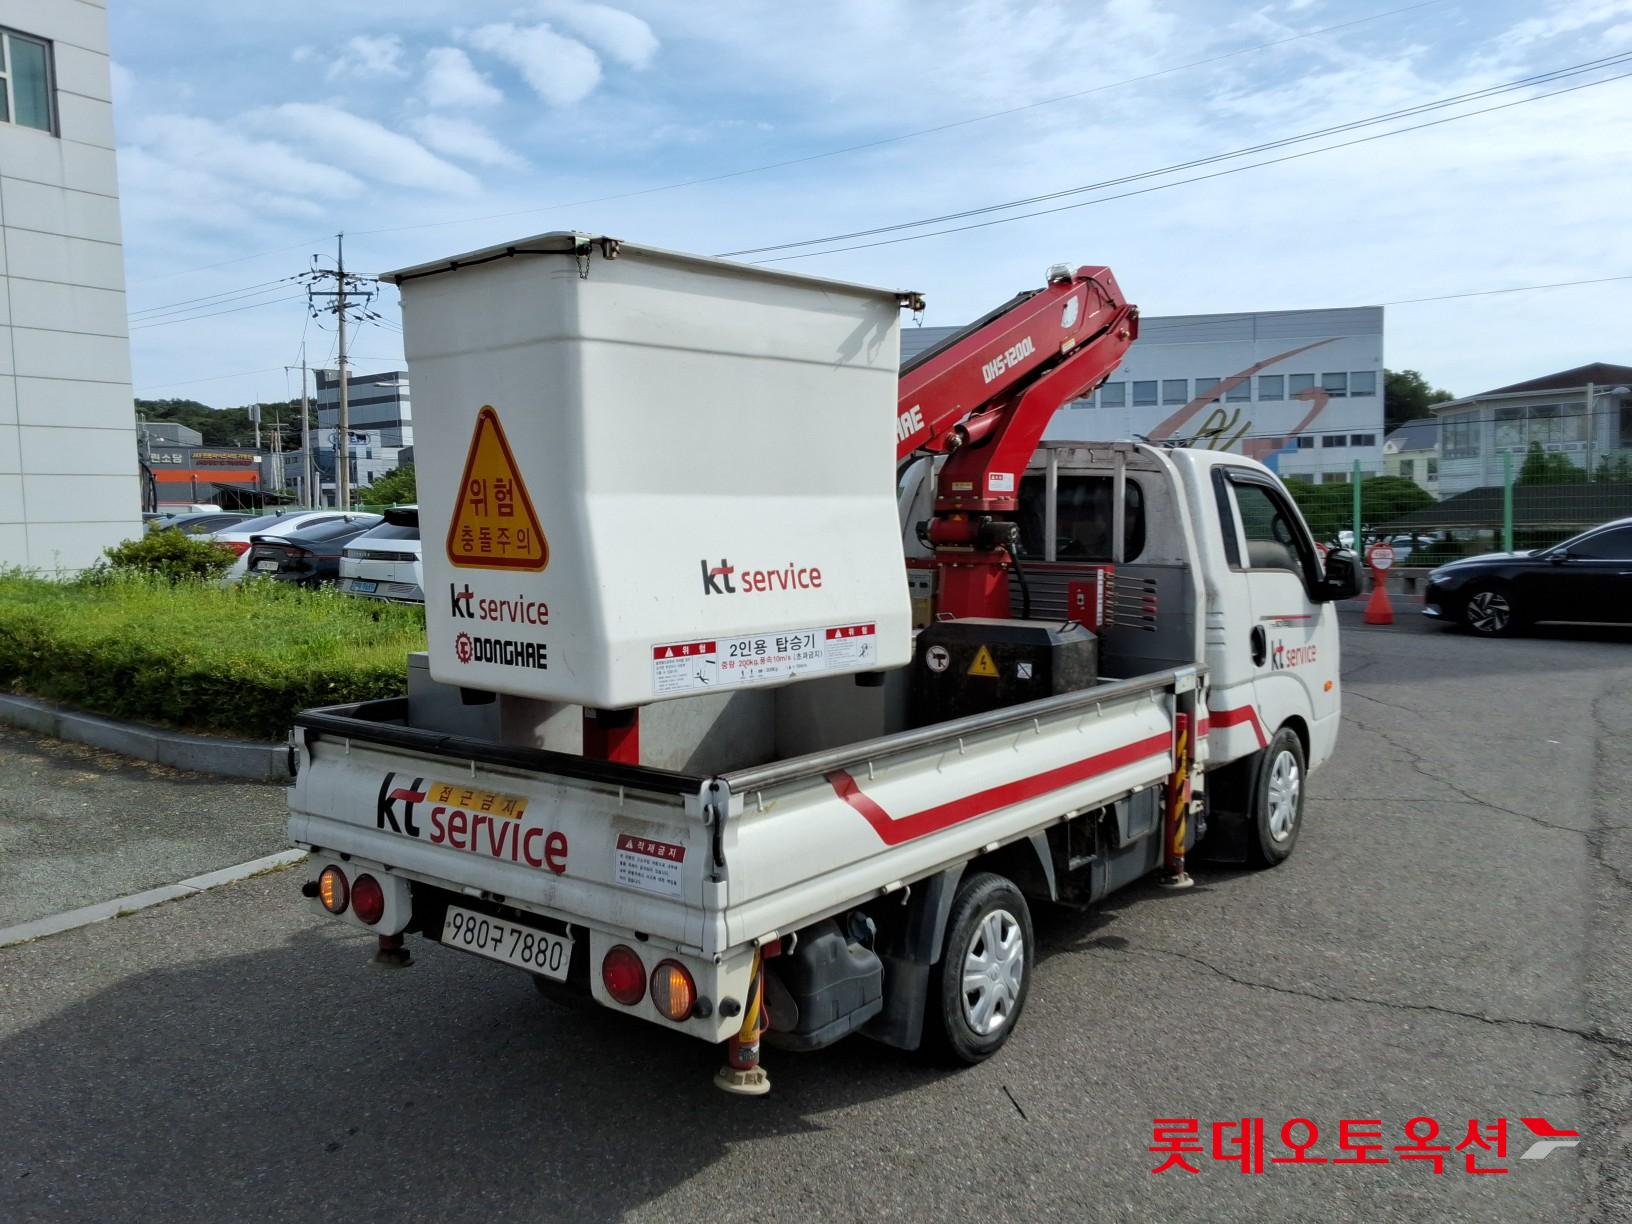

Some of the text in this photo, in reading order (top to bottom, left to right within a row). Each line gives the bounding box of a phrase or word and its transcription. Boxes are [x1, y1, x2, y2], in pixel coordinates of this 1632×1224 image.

[982, 336, 1036, 384] DHS-1200L
[469, 478, 514, 517] 위험
[461, 525, 531, 555] 충돌주의
[701, 559, 822, 595] kt service
[450, 583, 549, 625] kt service
[473, 637, 548, 670] DONGHAE
[729, 639, 767, 658] 2인용
[776, 633, 815, 653] 탑승기
[1271, 639, 1317, 670] kt service
[439, 786, 517, 816] 접근금지
[376, 772, 427, 838] kt
[430, 806, 568, 874] service
